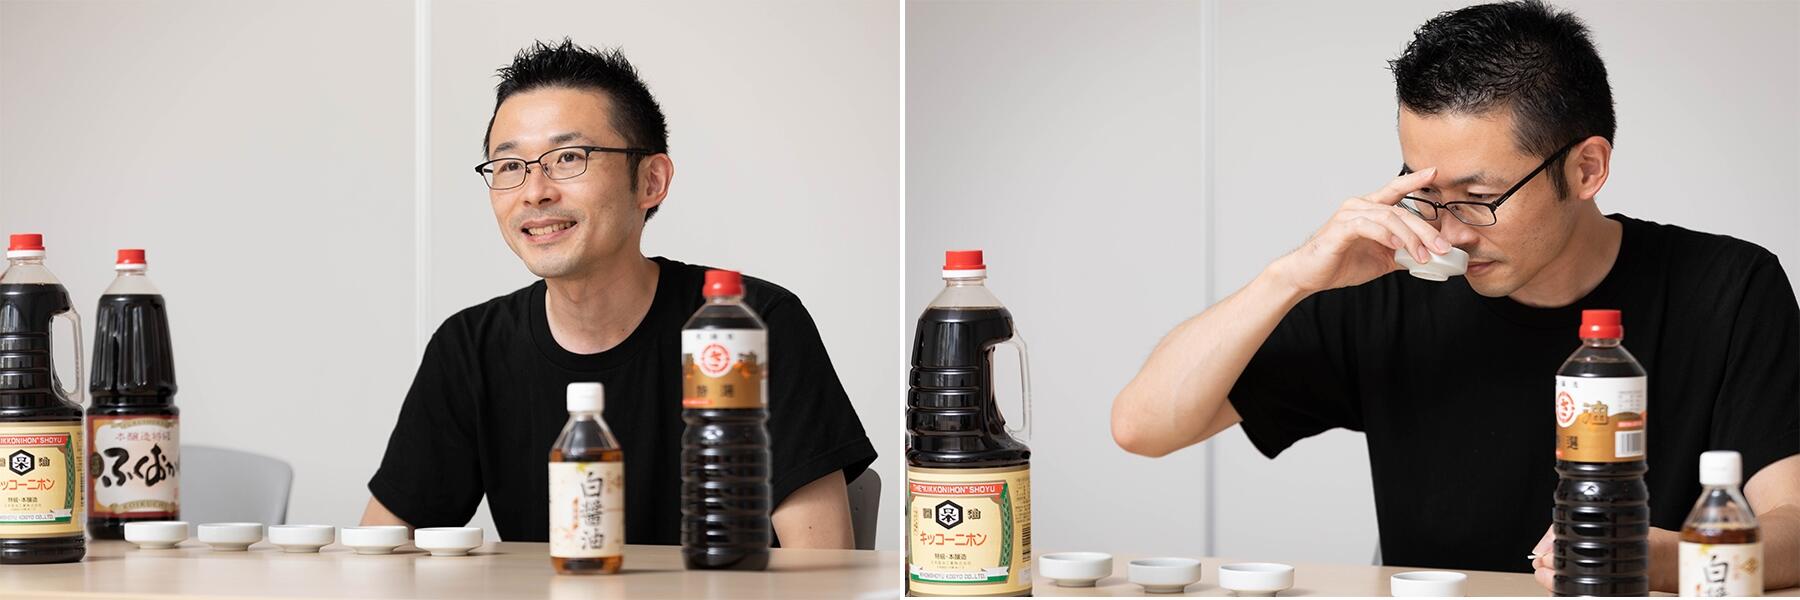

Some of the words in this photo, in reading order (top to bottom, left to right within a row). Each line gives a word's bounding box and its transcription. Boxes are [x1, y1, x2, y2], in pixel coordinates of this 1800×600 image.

[920, 531, 987, 546] キッコーニホン
